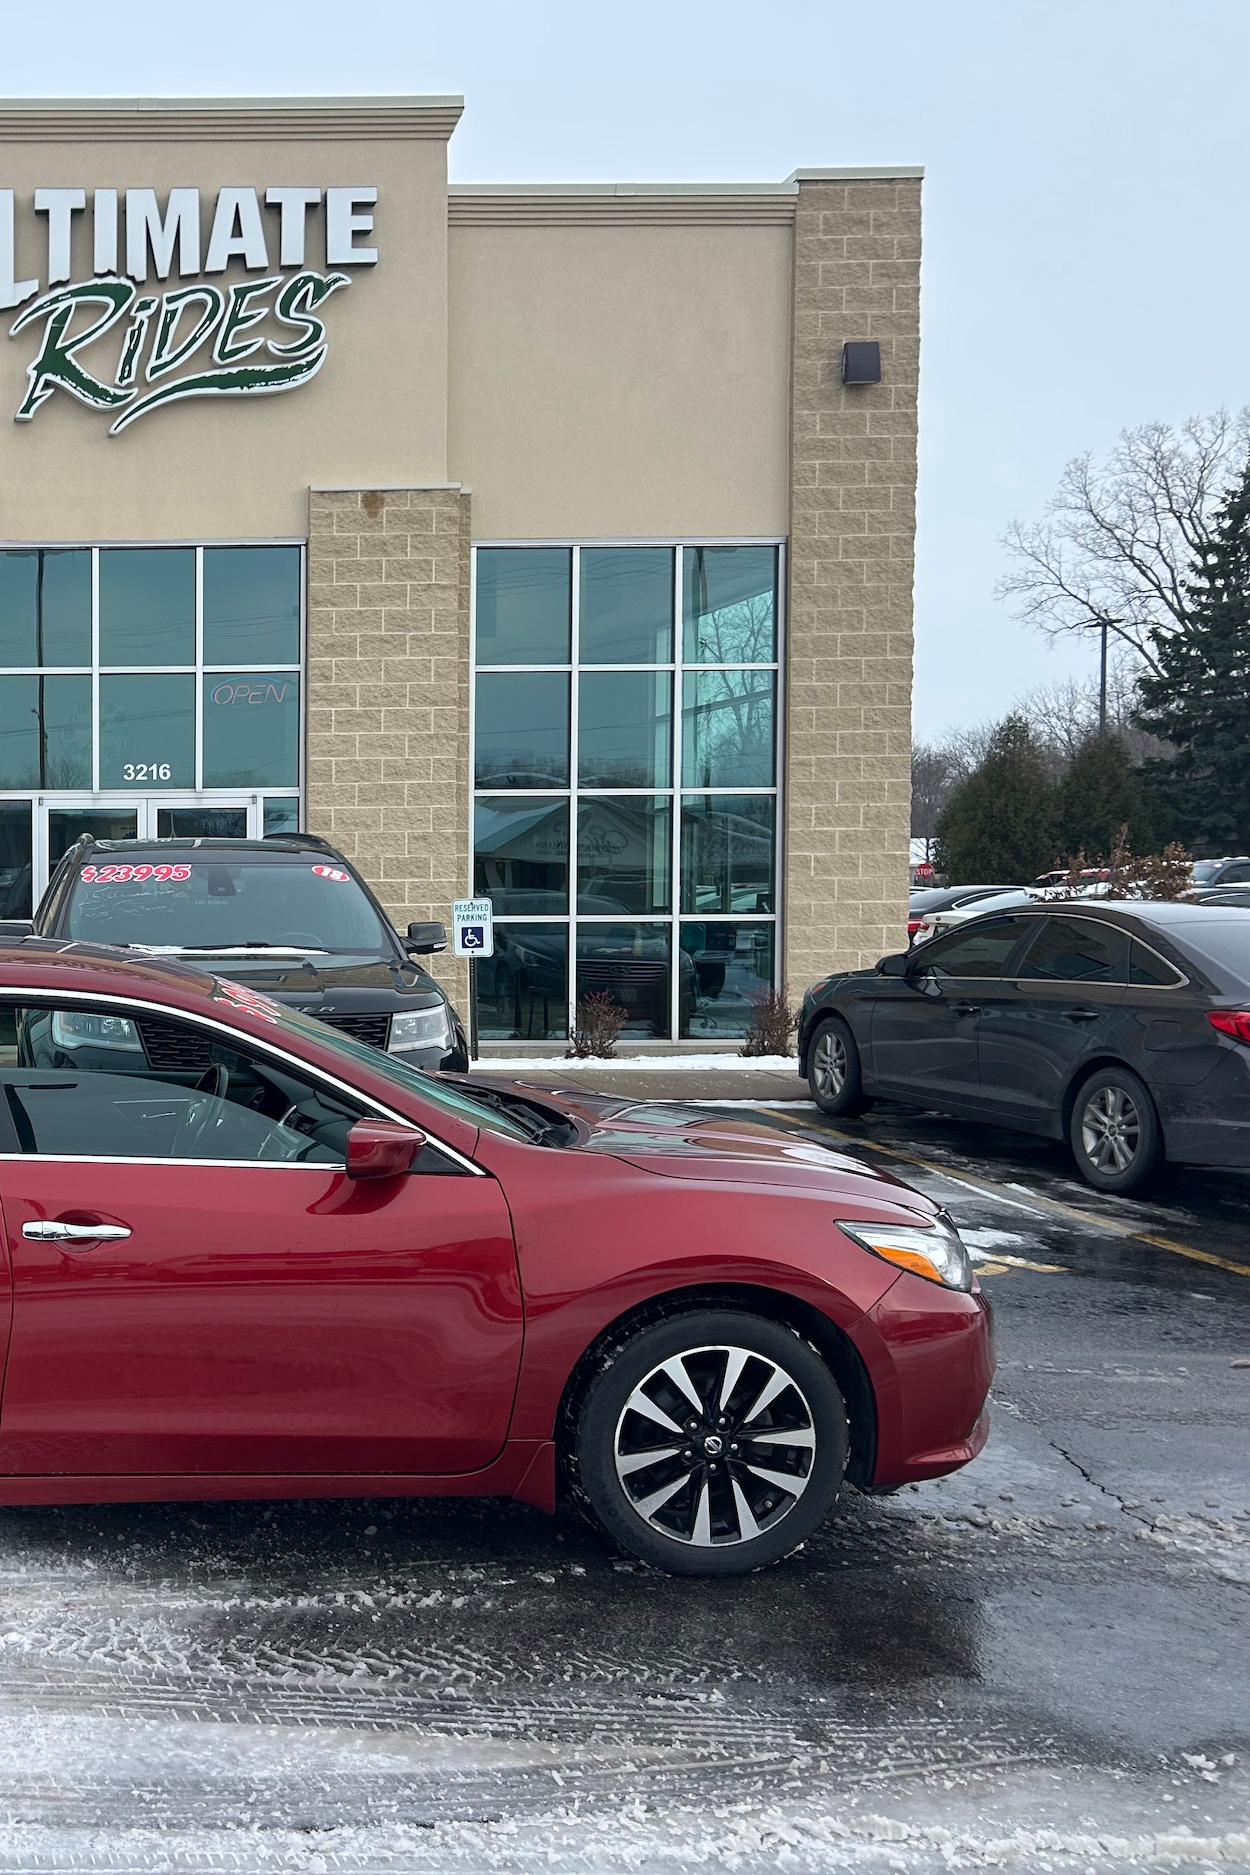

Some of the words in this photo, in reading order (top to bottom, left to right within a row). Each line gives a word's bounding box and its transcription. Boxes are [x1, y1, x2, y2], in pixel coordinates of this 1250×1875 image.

[213, 683, 287, 704] OPEN
[122, 763, 171, 781] 3216
[81, 864, 191, 883] $23995
[322, 867, 343, 880] 18
[454, 903, 489, 912] RESERVED
[456, 913, 487, 922] PARKING
